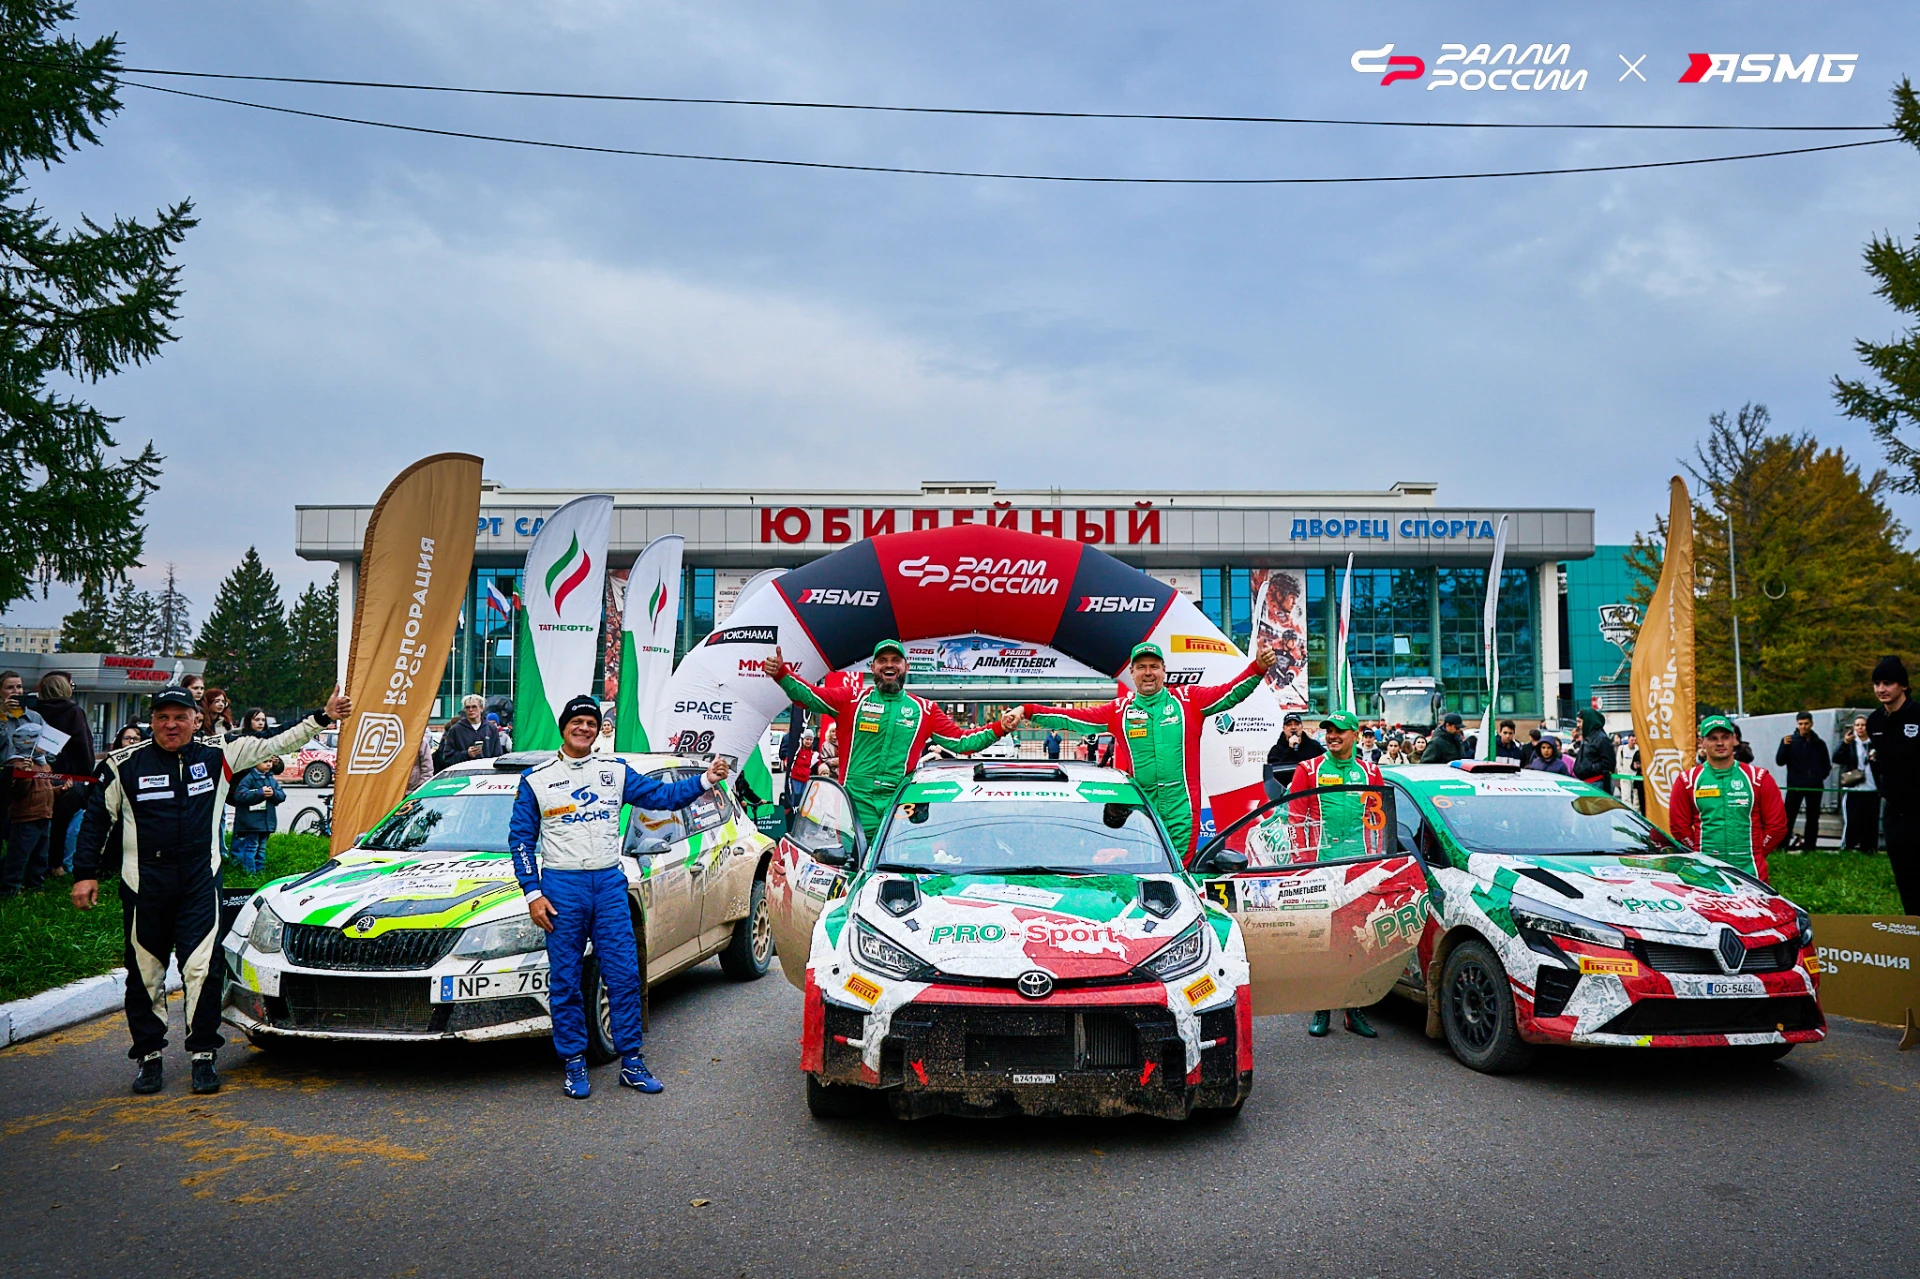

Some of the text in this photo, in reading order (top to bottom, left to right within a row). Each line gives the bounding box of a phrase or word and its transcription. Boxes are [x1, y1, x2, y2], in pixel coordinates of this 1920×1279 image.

[1289, 518, 1495, 541] ДВОРЕЦ СПОРТА
[954, 556, 1047, 576] РАЛЛИ
[948, 574, 1060, 595] РОССИИ
[805, 588, 881, 607] ASMG
[1084, 596, 1156, 612] ASMG
[383, 536, 436, 705] КОРПОРАЦИЯ
[539, 624, 594, 632] ТАТНЕФТЬ
[723, 629, 774, 641] YOKOHAMA
[1185, 638, 1228, 653] PIRELLI
[972, 656, 1058, 670] АЛЬМЕТЬЕВСК
[397, 643, 428, 705] РУСЬ
[674, 701, 733, 715] SPACE
[703, 713, 732, 722] TRAVEL
[1360, 790, 1387, 831] 3
[1432, 795, 1453, 809] 6
[561, 810, 611, 824] SACHS
[1214, 884, 1229, 909] 3
[1278, 883, 1327, 901] АЛЬМЕТЬЕВСК
[1251, 921, 1296, 929] ТАТНЕФТЬ
[1583, 959, 1633, 973] PIRELLI
[1815, 946, 1910, 970] РПОРАЦИЯ
[847, 976, 879, 1001] PIRELLI
[1187, 979, 1216, 1003] PIRELLI
